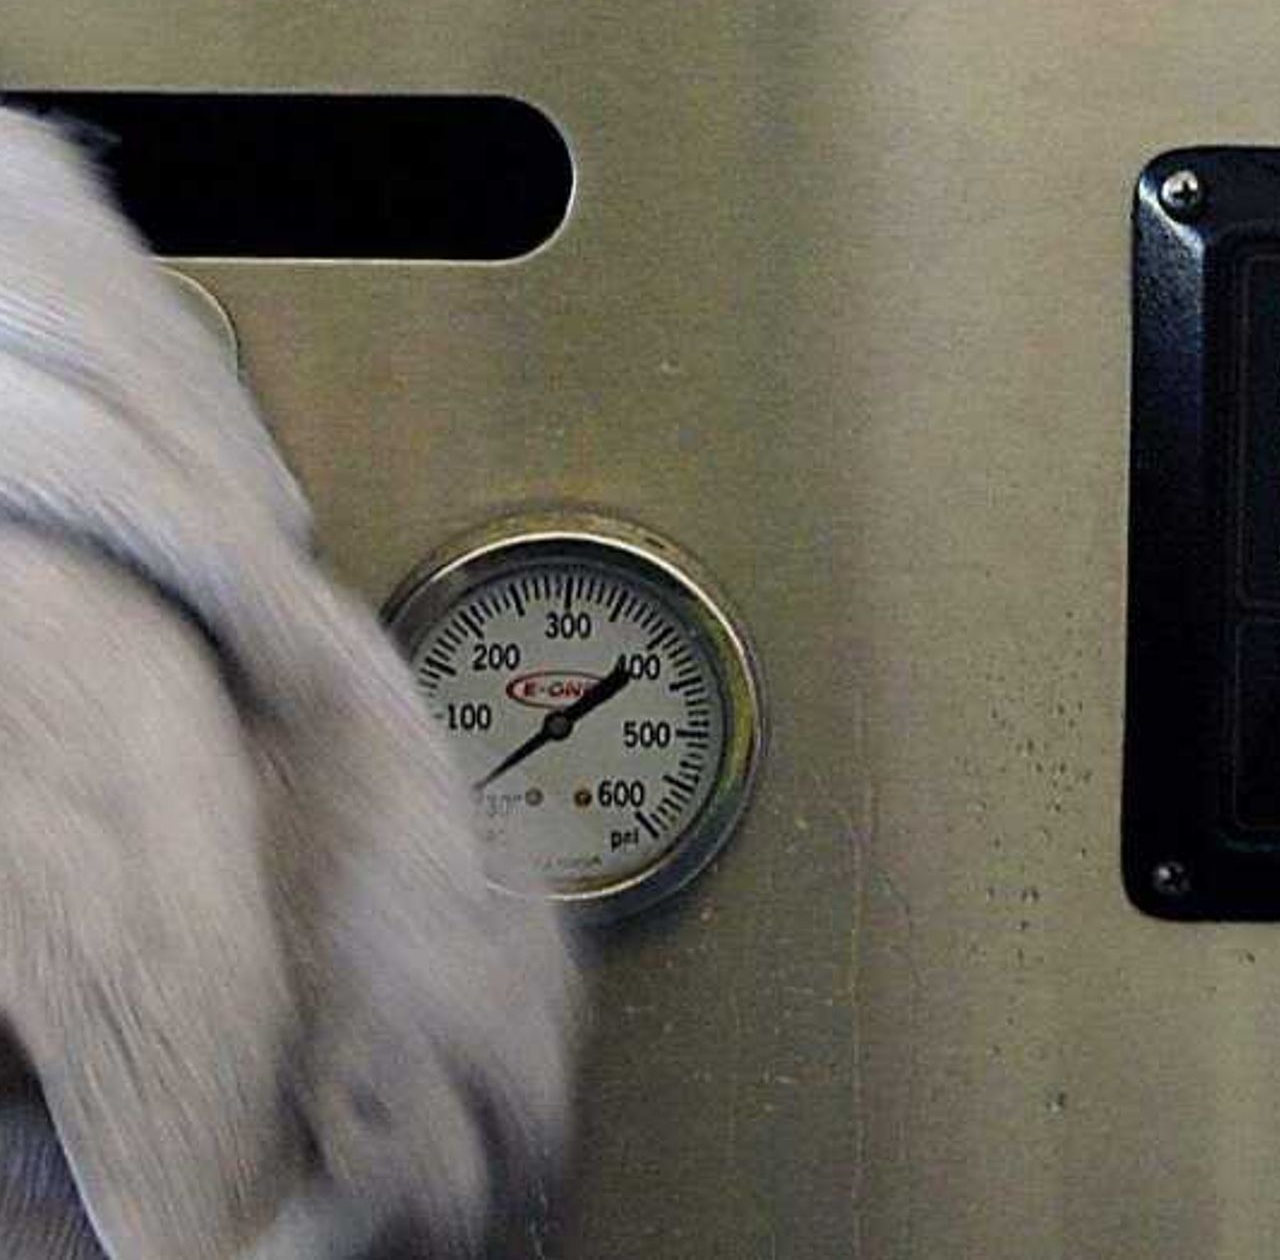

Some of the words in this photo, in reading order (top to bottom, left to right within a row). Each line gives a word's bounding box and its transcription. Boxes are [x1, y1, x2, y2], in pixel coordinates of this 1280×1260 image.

[545, 613, 591, 639] 300
[473, 644, 519, 670] 200
[524, 679, 590, 698] E-ON
[448, 704, 491, 730] 100
[624, 722, 670, 748] 500
[598, 781, 644, 807] 600
[611, 830, 639, 851] psi
